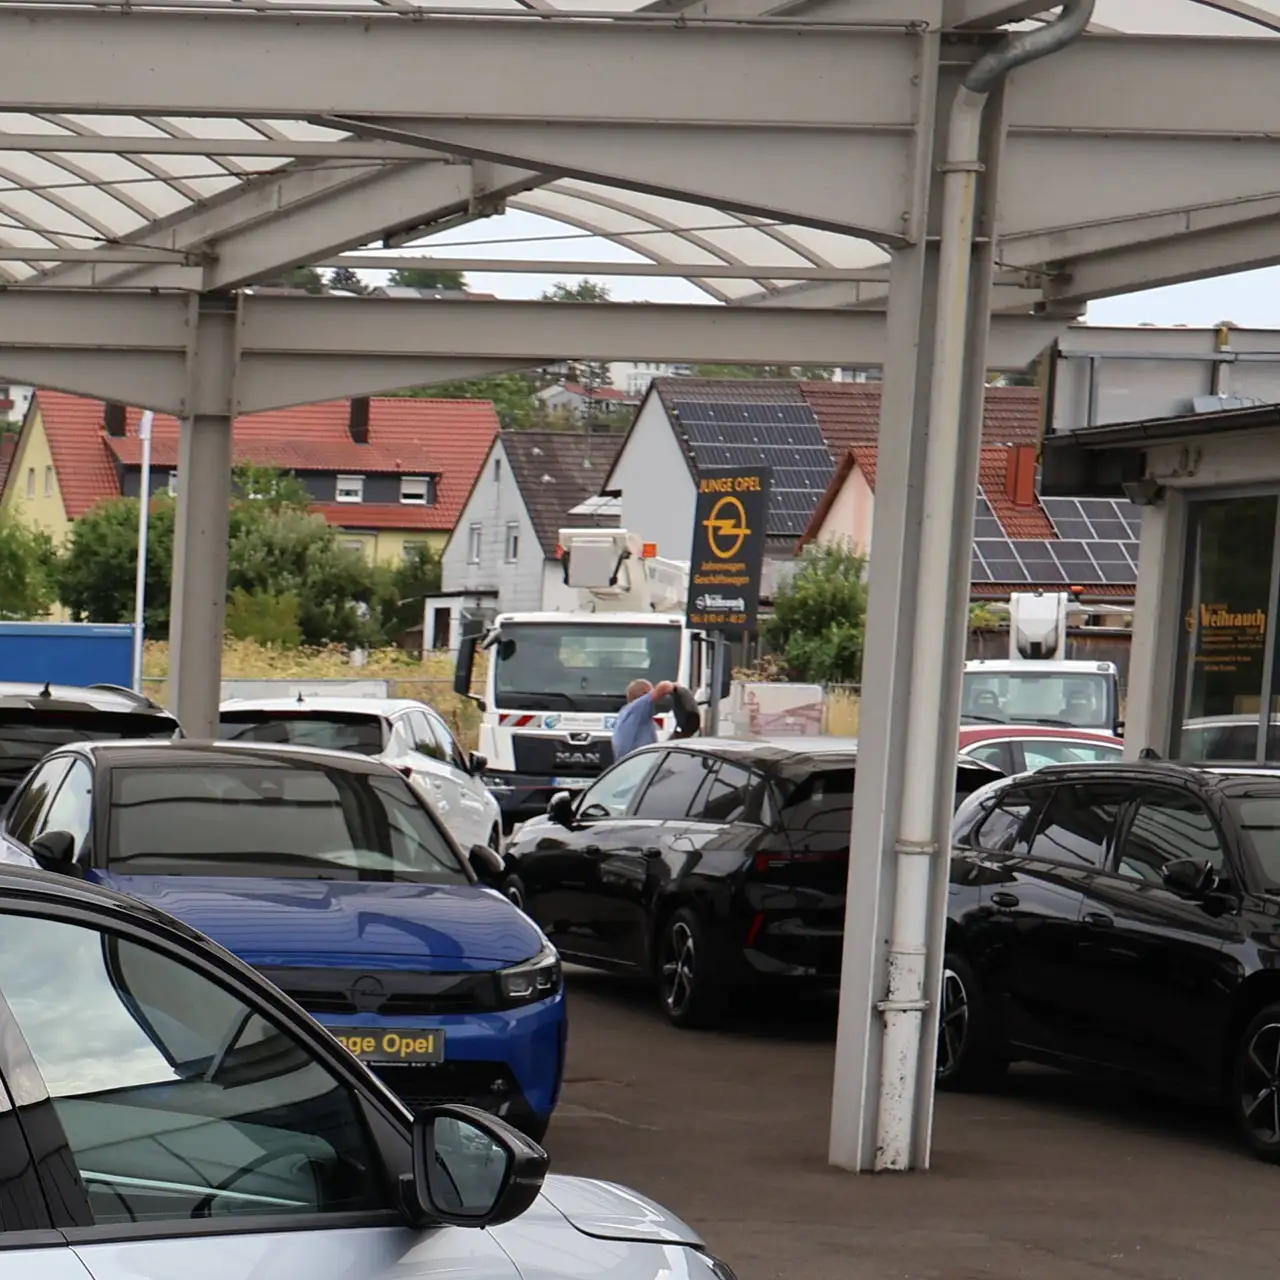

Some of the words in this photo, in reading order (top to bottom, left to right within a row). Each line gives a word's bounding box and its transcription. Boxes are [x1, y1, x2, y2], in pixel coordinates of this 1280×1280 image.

[699, 478, 733, 493] JUNGE
[735, 476, 761, 492] OPEL
[1201, 603, 1266, 634] Weihrauch
[555, 752, 601, 763] MAN
[336, 1036, 376, 1056] nge
[382, 1033, 434, 1058] Opel
